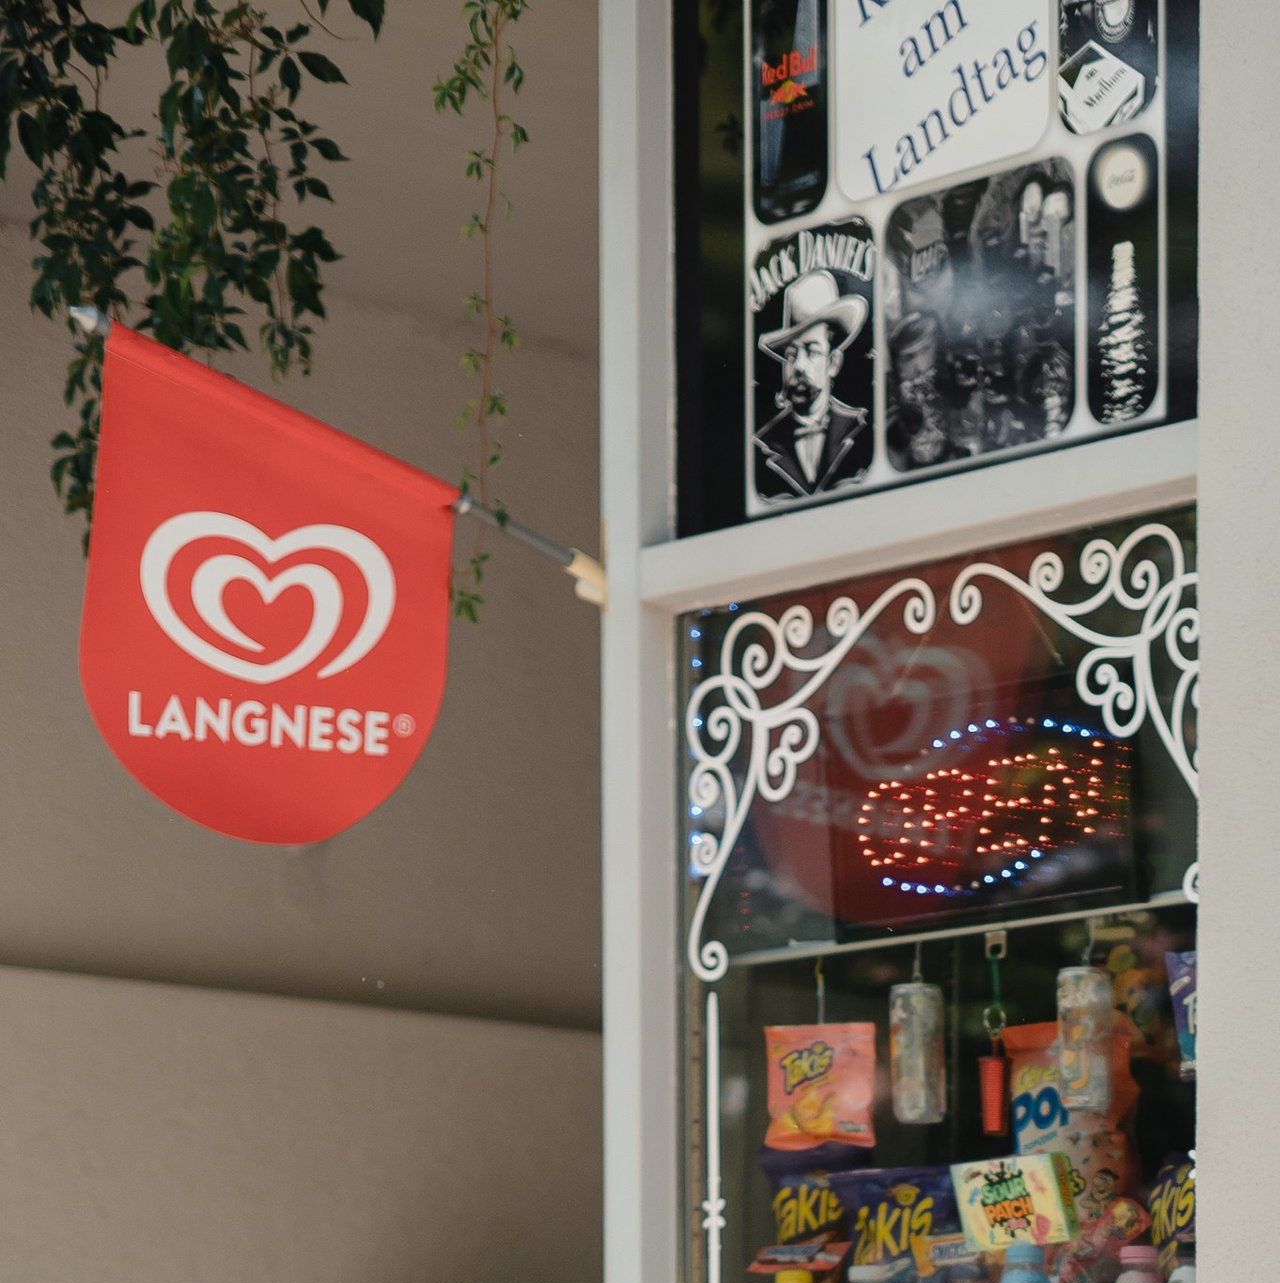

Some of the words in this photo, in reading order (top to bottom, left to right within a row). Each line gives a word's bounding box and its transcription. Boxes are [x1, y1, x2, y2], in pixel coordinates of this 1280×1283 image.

[761, 53, 789, 86] Red
[789, 45, 817, 77] Bull
[899, 0, 968, 78] am
[861, 19, 1048, 195] Landtag
[128, 690, 390, 757] LANGNESE
[857, 740, 1105, 866] OPEN
[982, 1177, 1028, 1204] SOUR
[984, 1197, 1035, 1226] PATCH
